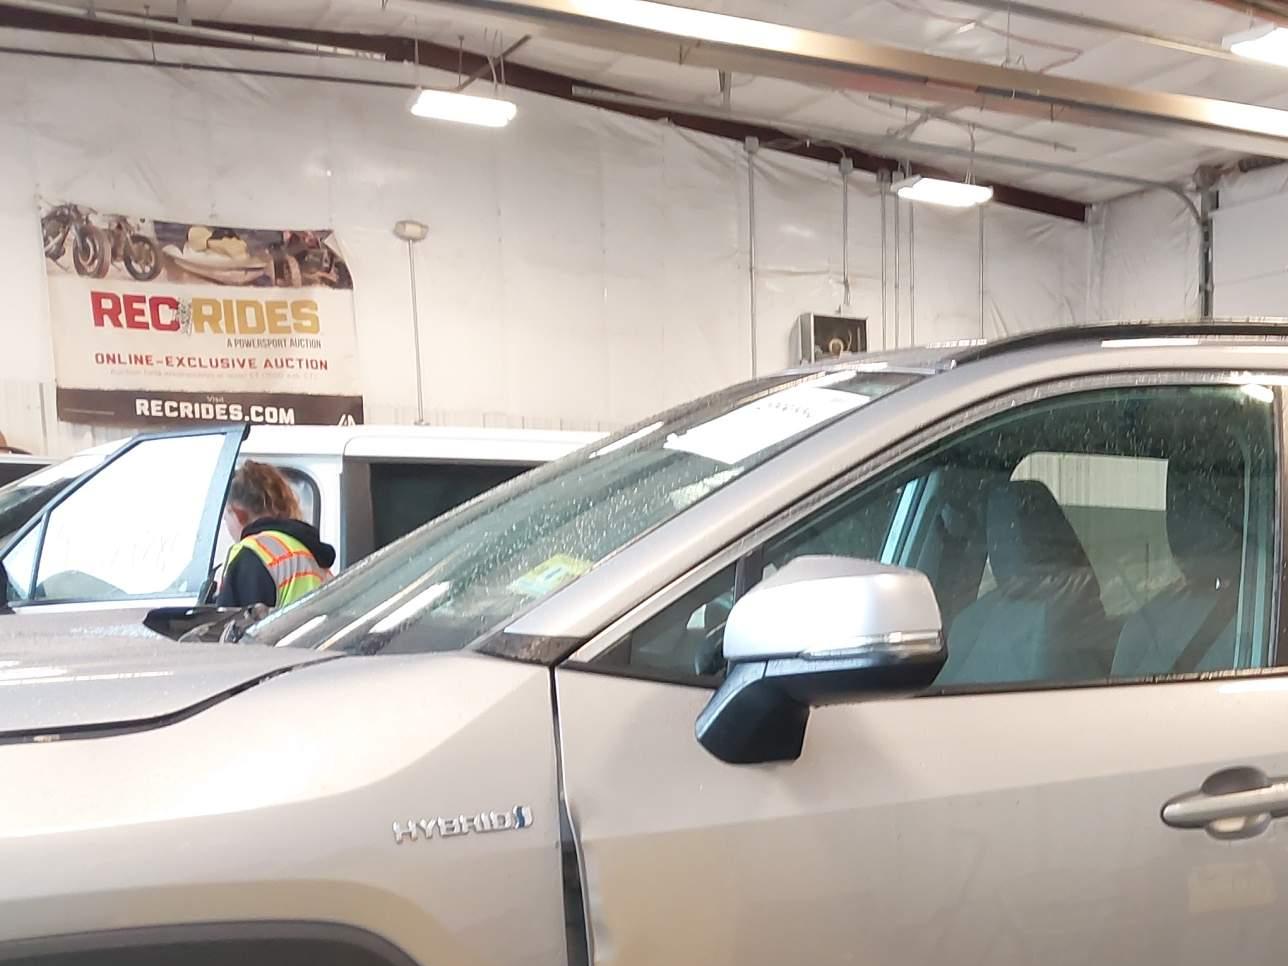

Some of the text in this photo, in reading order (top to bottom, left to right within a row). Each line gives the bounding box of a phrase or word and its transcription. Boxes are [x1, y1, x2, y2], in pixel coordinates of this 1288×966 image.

[90, 291, 321, 335] REC RIDES
[227, 338, 322, 349] A POWERSPORT AUCTION
[95, 353, 328, 371] ONLINE-EXCLUSIVE AUCTION
[135, 398, 295, 425] RECRIDES.COM
[392, 810, 513, 844] HYBRID
